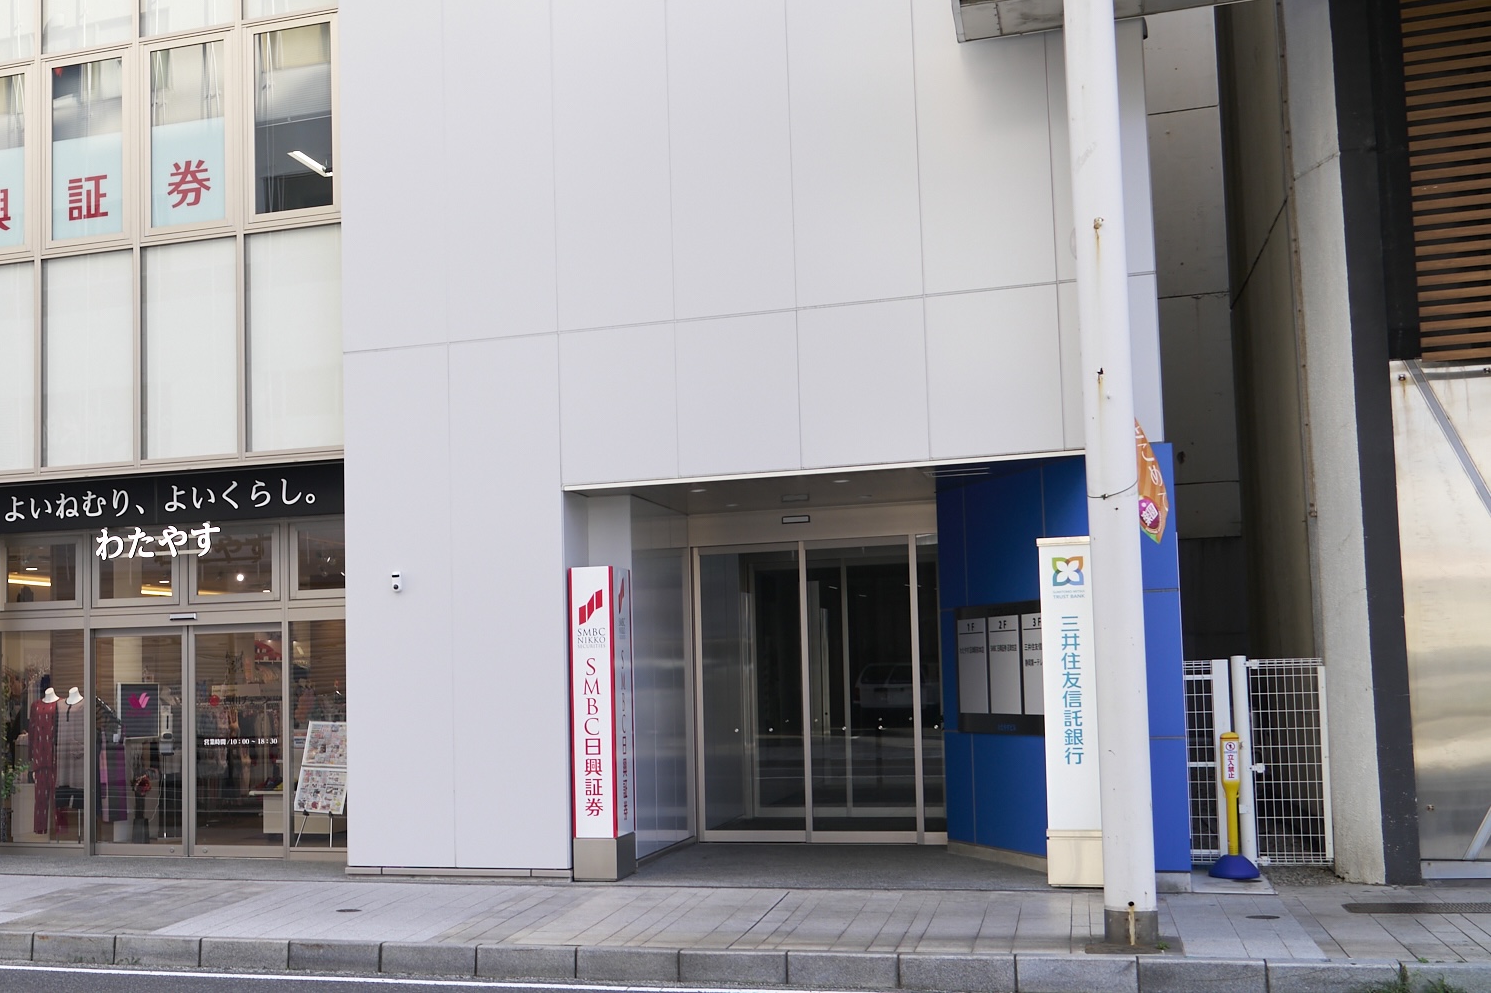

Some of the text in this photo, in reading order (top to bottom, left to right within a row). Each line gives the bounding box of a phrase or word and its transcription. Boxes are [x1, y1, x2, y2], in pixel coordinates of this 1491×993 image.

[4, 478, 317, 523] よいねむり、よいくらし。
[95, 521, 221, 561] わたやす
[967, 622, 975, 632] 1F
[998, 620, 1007, 630] 2F
[1032, 617, 1042, 627] 3F
[577, 627, 606, 636] SMBC
[577, 636, 606, 644] NIKKO
[1061, 616, 1084, 765] 三井住友信託銀行
[583, 658, 603, 816] SMBC日興証券
[1227, 754, 1235, 779] 立入禁止
